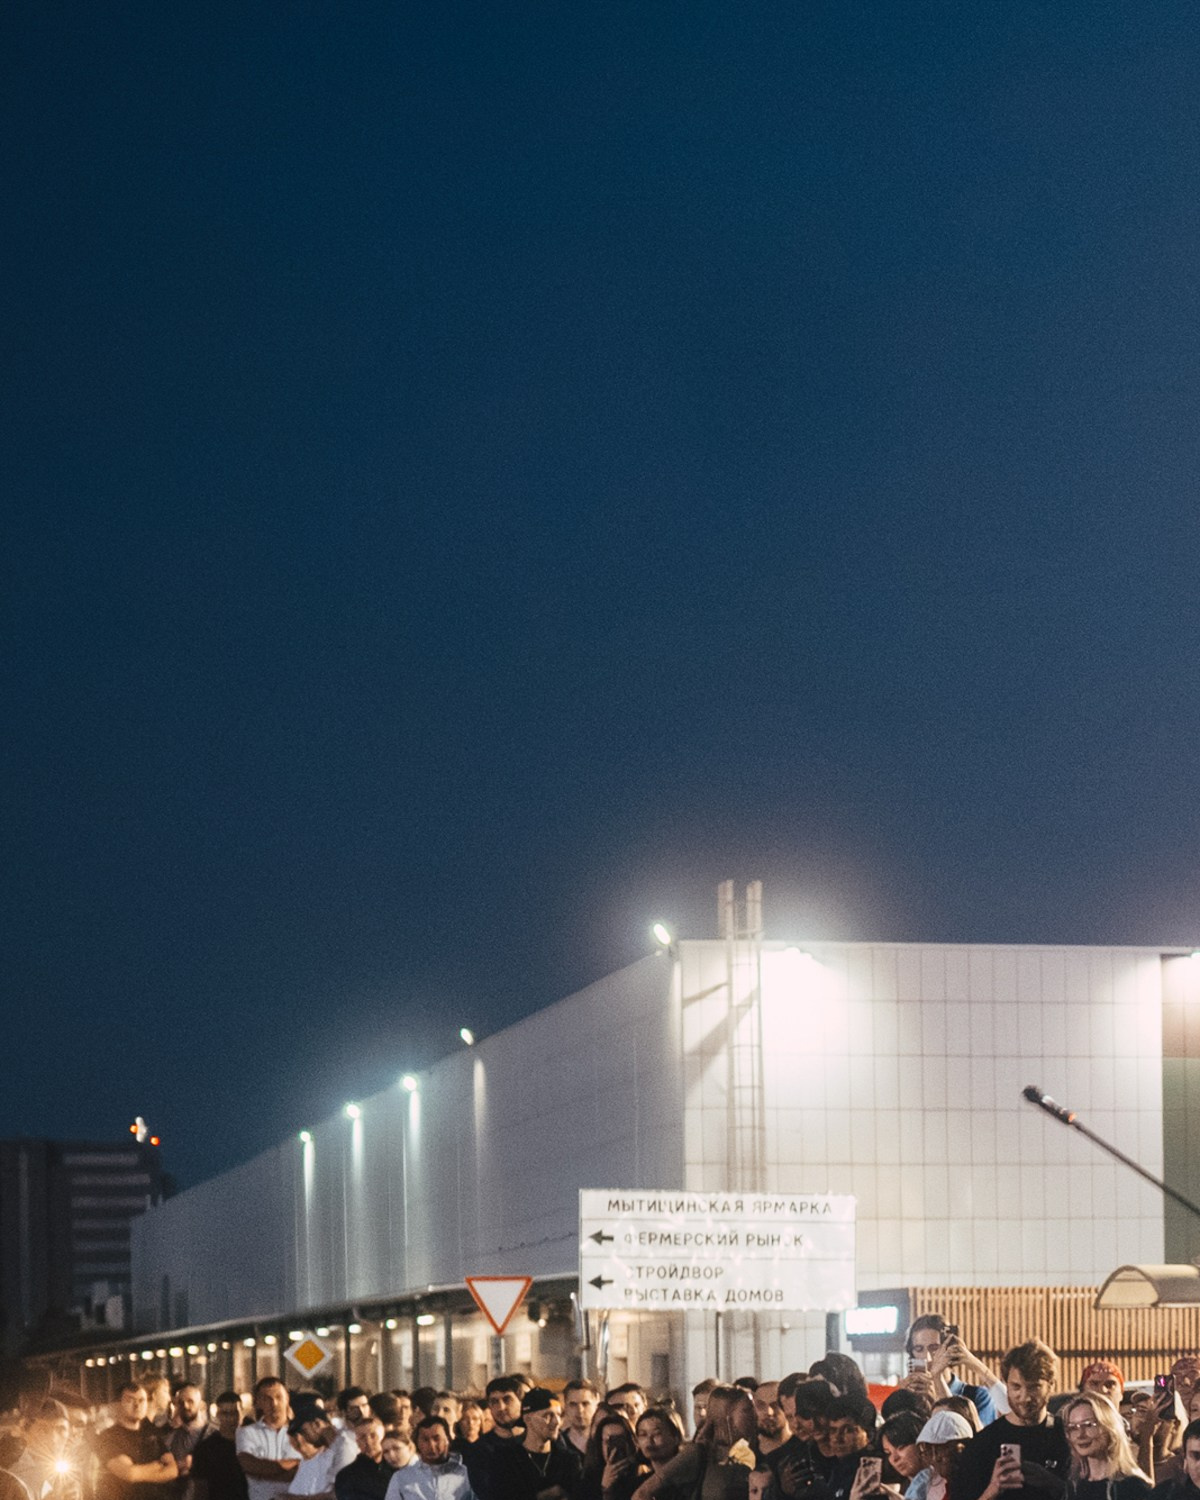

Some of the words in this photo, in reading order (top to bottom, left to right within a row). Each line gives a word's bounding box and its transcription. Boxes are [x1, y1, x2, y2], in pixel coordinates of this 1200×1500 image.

[753, 1200, 832, 1215] ЯРМАРКА
[746, 1233, 804, 1247] РЫНК
[626, 1263, 724, 1280] ТРОЙДВОР
[725, 1288, 784, 1303] ДОМОВ
